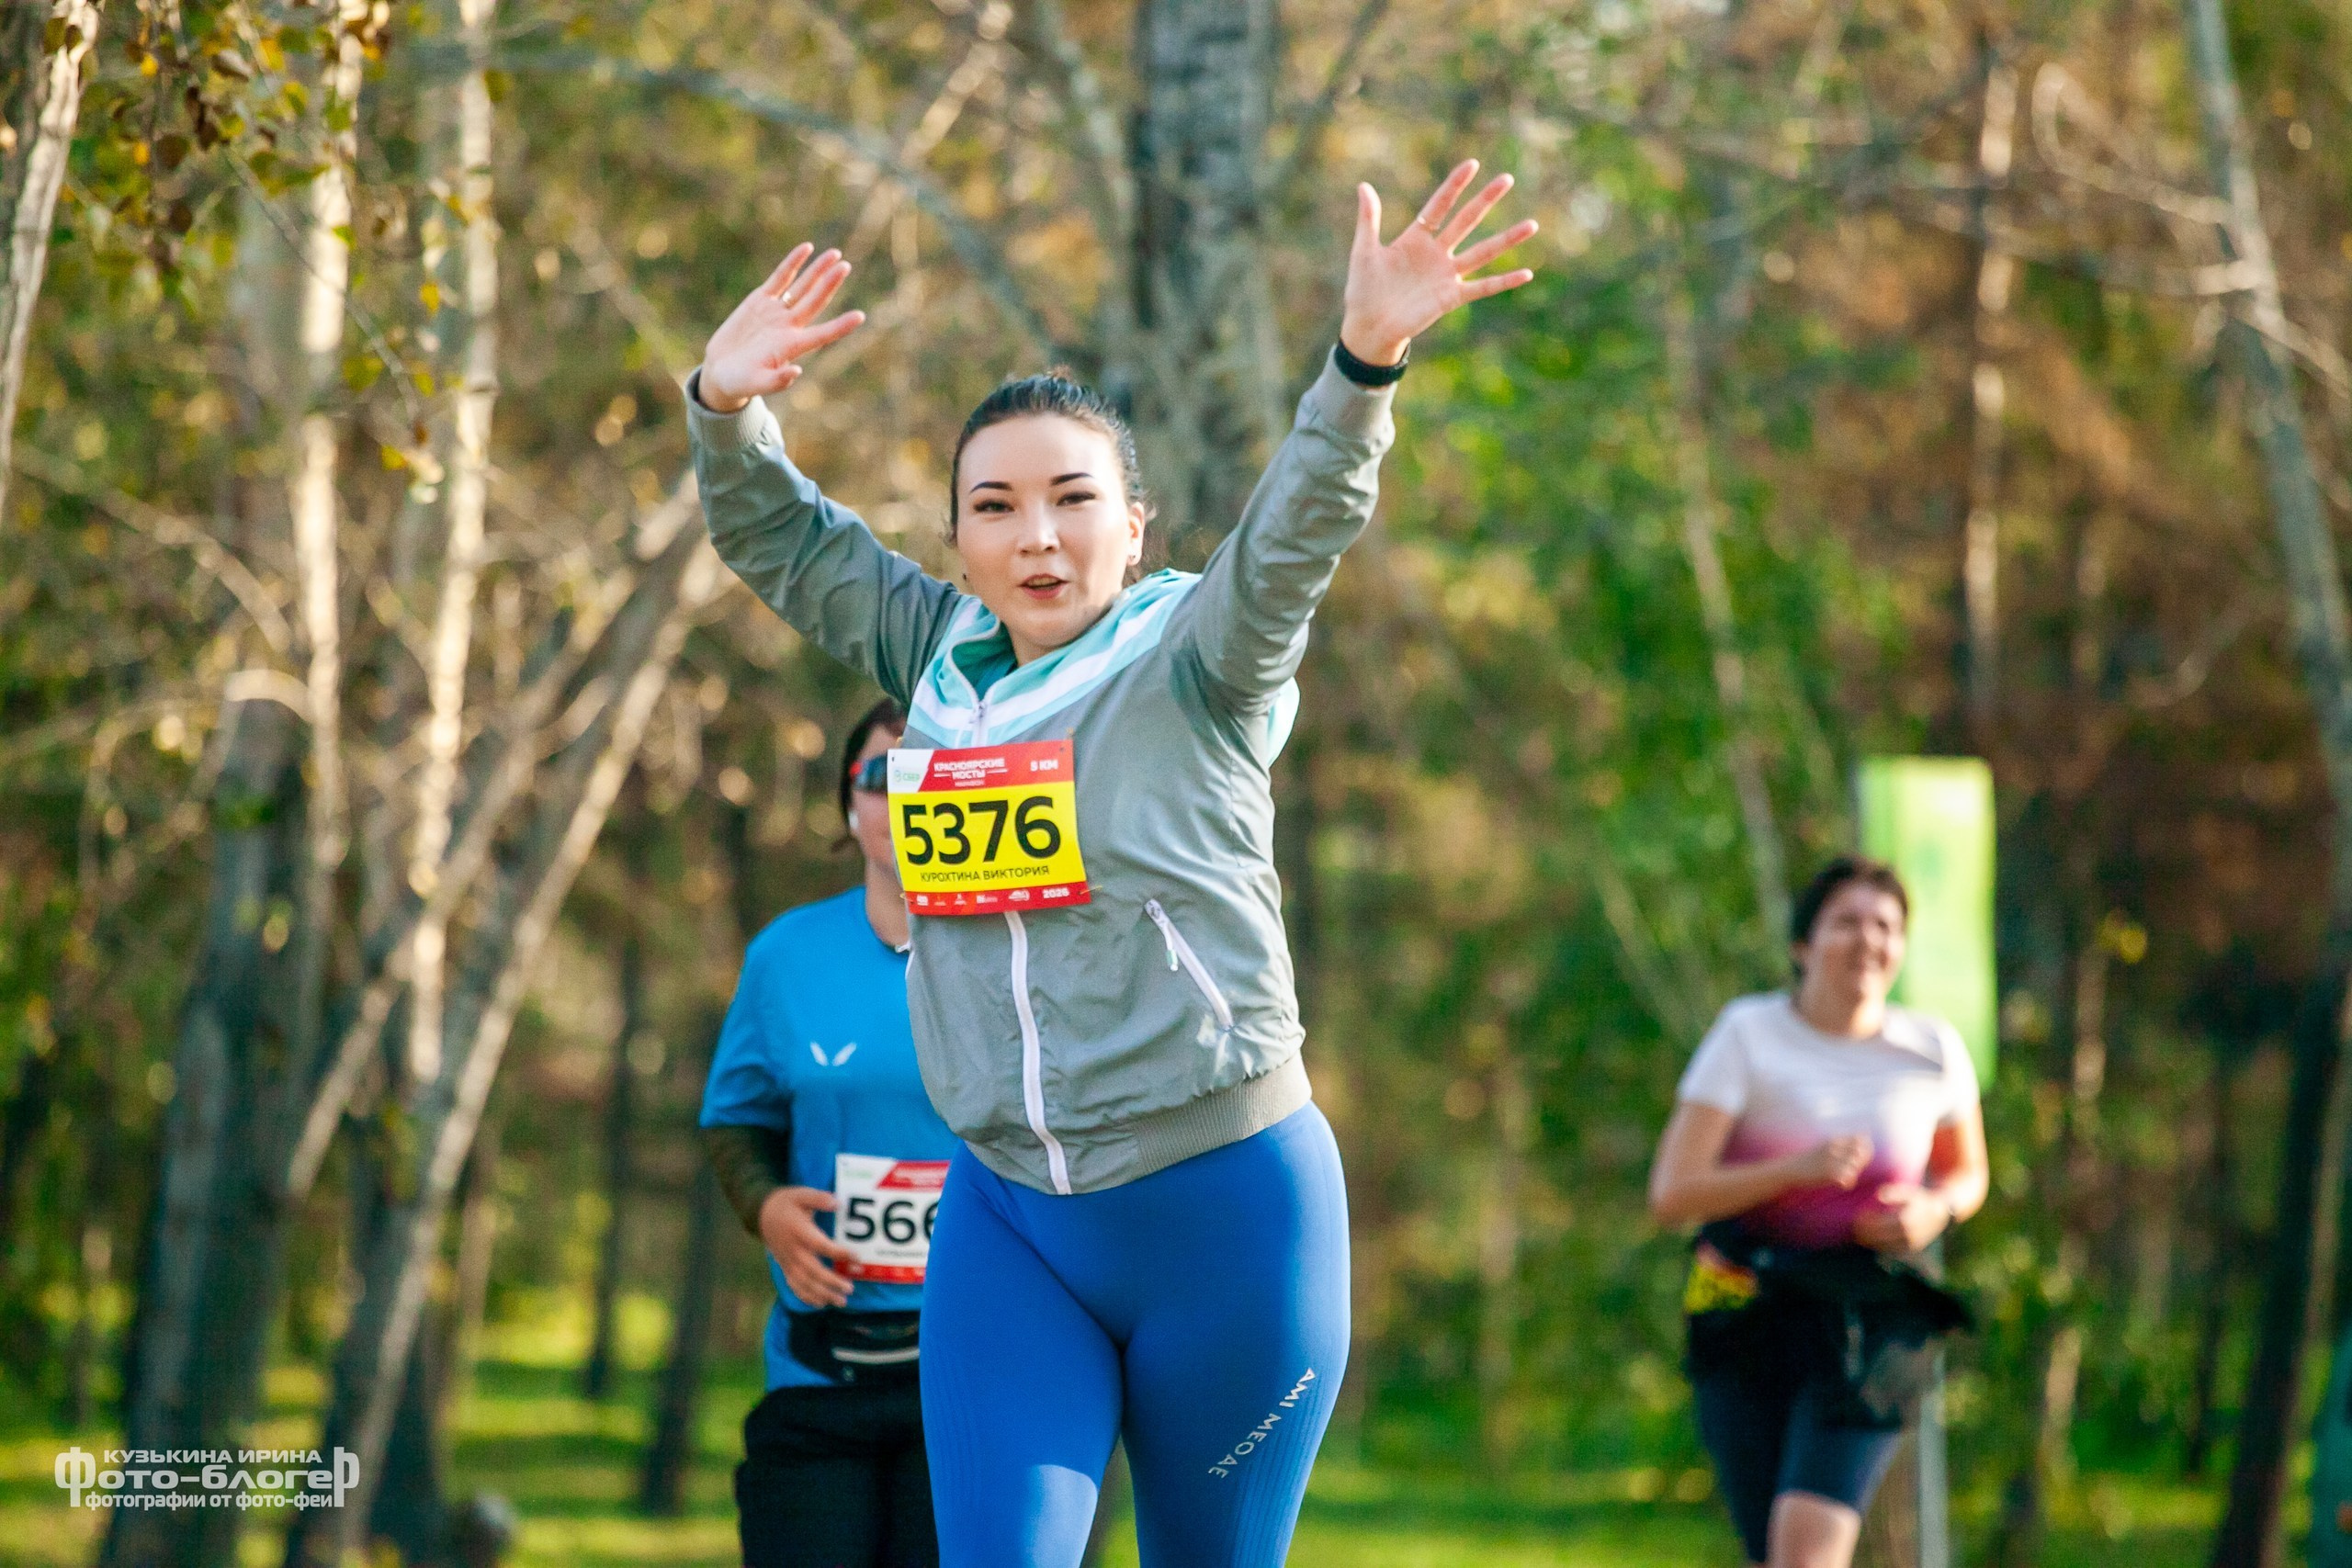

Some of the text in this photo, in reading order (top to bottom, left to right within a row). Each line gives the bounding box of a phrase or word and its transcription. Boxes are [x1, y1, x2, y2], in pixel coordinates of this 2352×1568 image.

[933, 759, 1005, 772] КРАСНОЯРСКИЕ
[1039, 759, 1058, 771] КМ
[952, 770, 986, 780] МОСТЫ
[902, 795, 1061, 865] 5376
[921, 865, 1050, 883] КУРОХТИНА ВИКТОРИЯ
